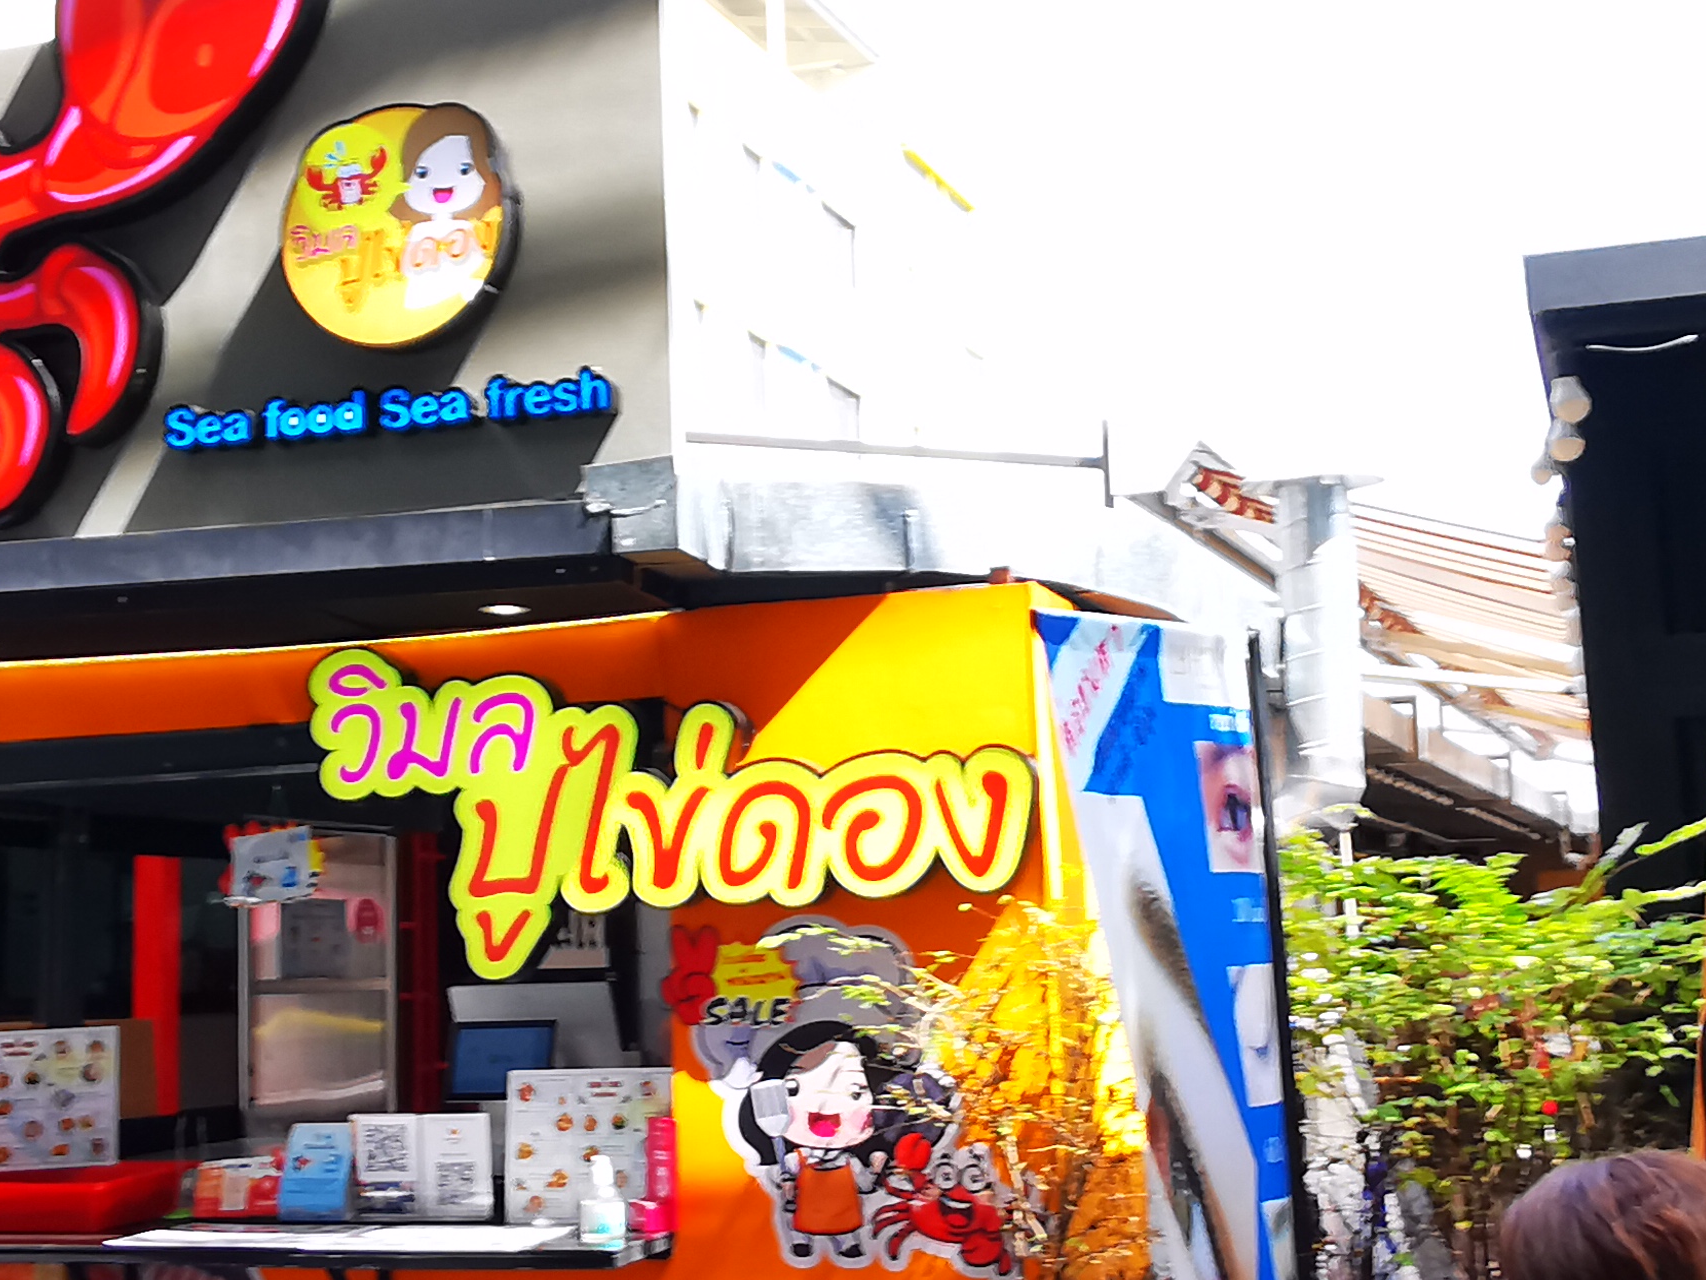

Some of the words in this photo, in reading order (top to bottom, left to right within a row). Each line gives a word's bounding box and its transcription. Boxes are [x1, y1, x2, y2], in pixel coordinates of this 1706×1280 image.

[164, 405, 253, 451] Sea
[261, 387, 368, 442] food
[378, 386, 472, 433] Sea
[485, 365, 613, 420] fresh
[327, 662, 536, 784] วิมล
[466, 720, 1009, 963] ปูไข่ดอง
